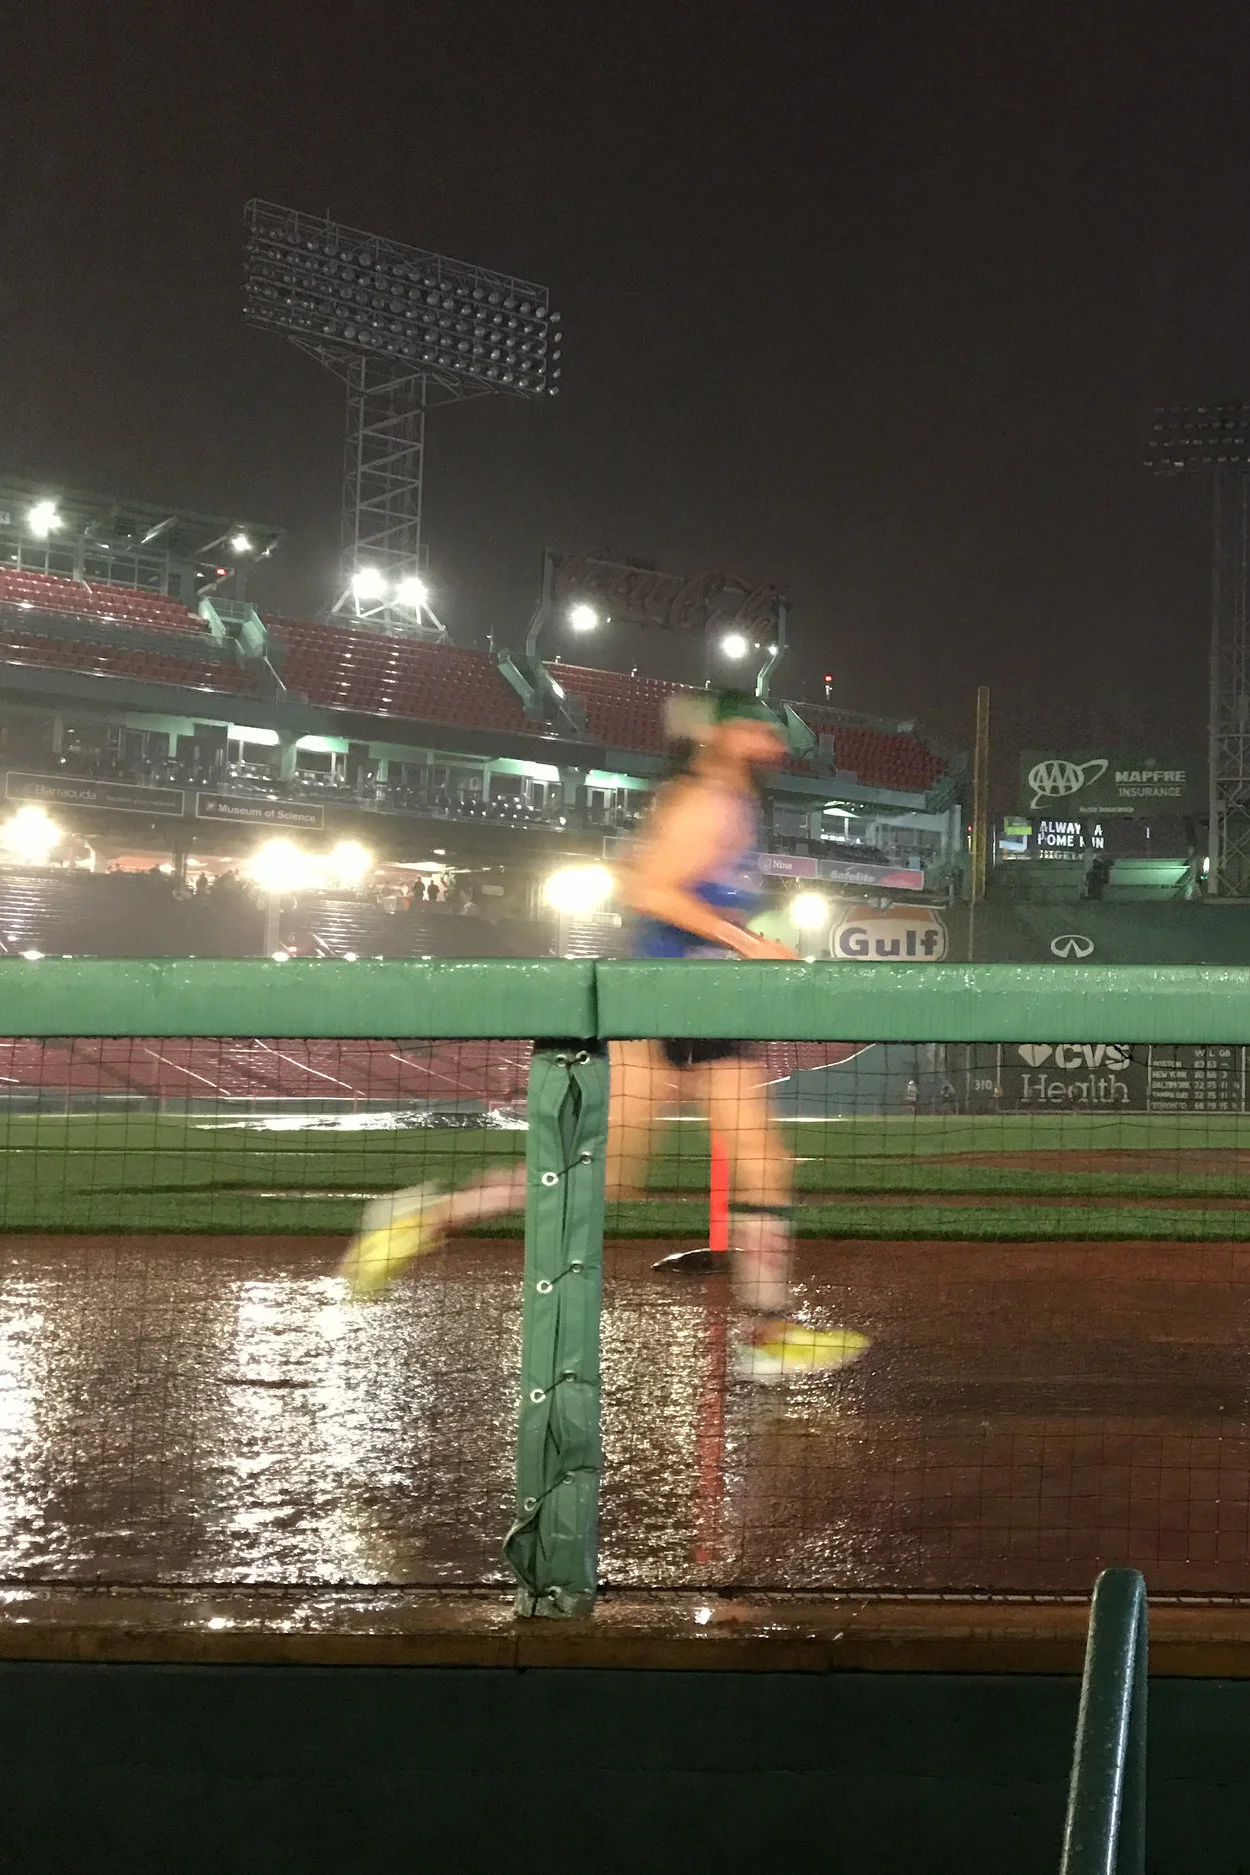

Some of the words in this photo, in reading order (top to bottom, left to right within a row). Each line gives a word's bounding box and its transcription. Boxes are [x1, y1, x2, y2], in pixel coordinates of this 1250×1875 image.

[1115, 771, 1186, 783] MAPFRE
[35, 784, 97, 800] Barracuda
[1119, 786, 1182, 797] INSURANCE
[218, 803, 262, 817] Museum
[264, 810, 275, 819] of
[277, 810, 316, 823] Science
[1039, 820, 1082, 835] ALWAY
[831, 869, 875, 883] Safelite
[840, 927, 939, 957] Gulf
[1055, 1044, 1130, 1071] CVS
[1195, 1049, 1206, 1057] W
[974, 1079, 993, 1090] 310
[1021, 1074, 1130, 1103] Health
